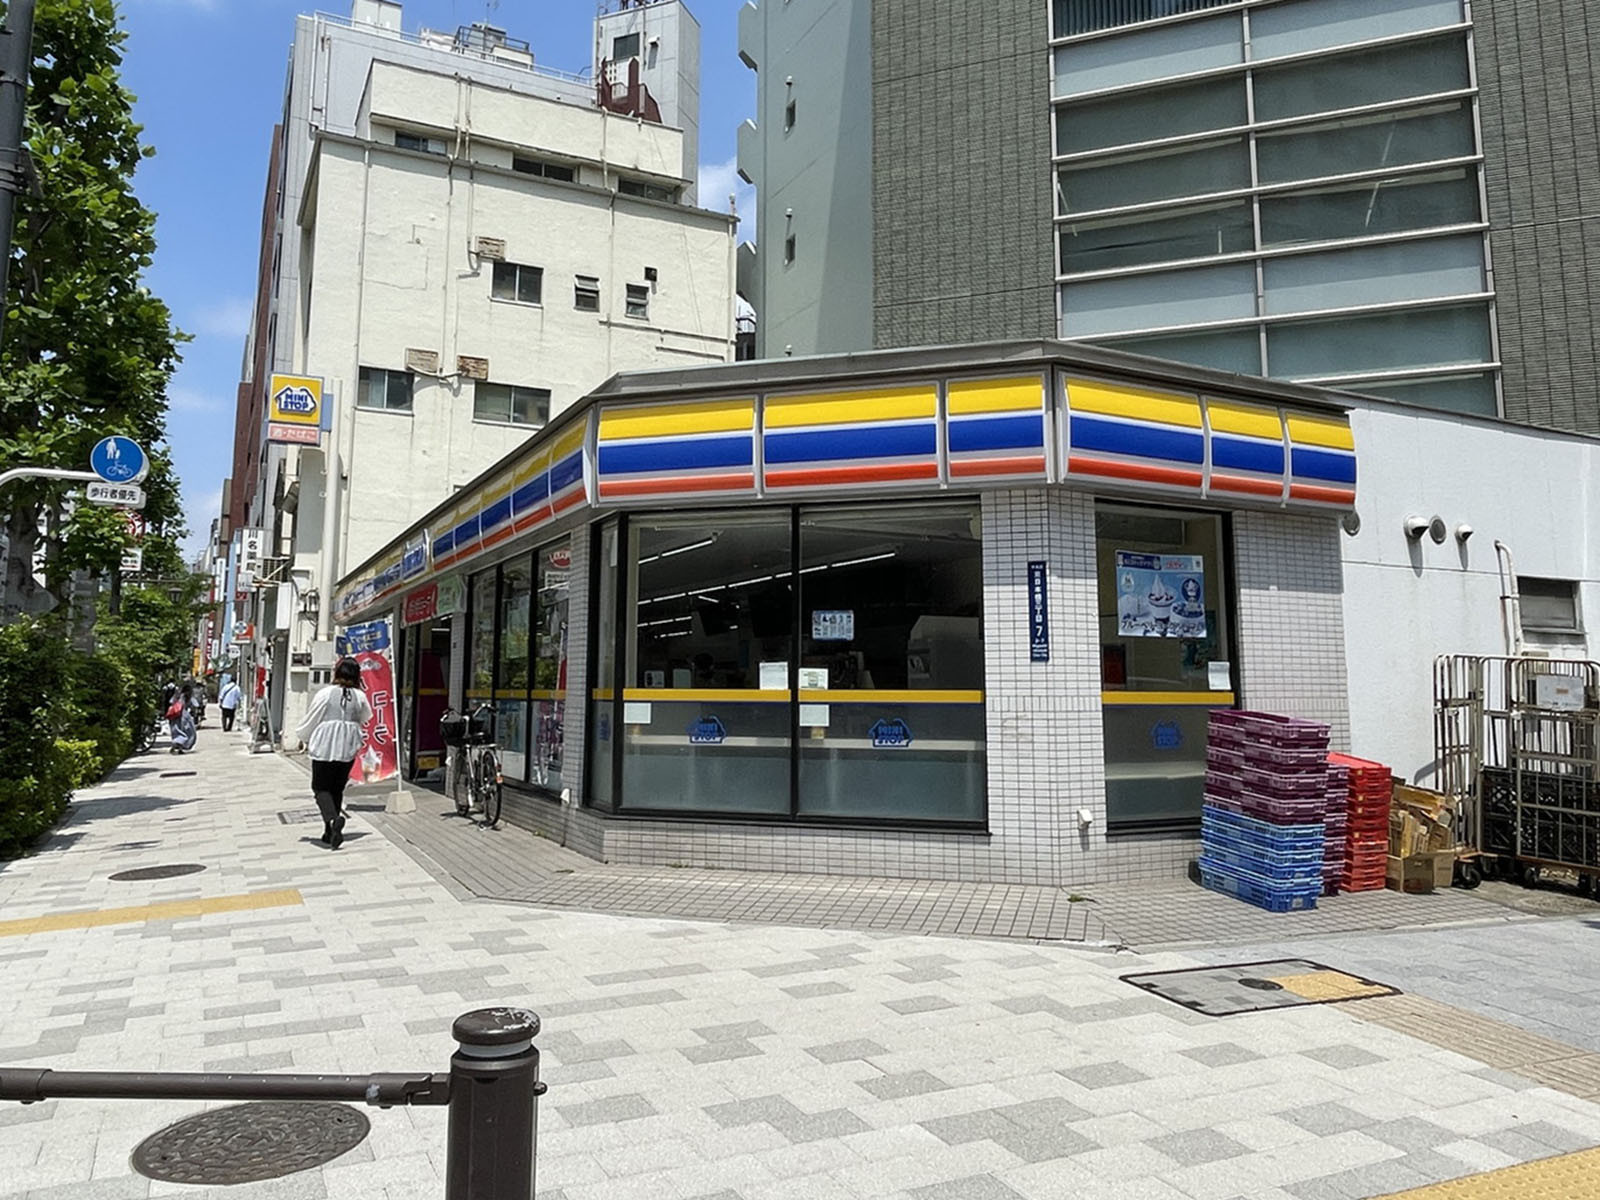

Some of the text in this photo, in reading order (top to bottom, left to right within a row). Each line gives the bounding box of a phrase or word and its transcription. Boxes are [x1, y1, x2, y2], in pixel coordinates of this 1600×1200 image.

[285, 393, 308, 402] MINI
[284, 401, 309, 410] STOP
[91, 487, 136, 501] 歩行者優先
[1035, 625, 1043, 636] 7
[877, 735, 905, 745] STOP
